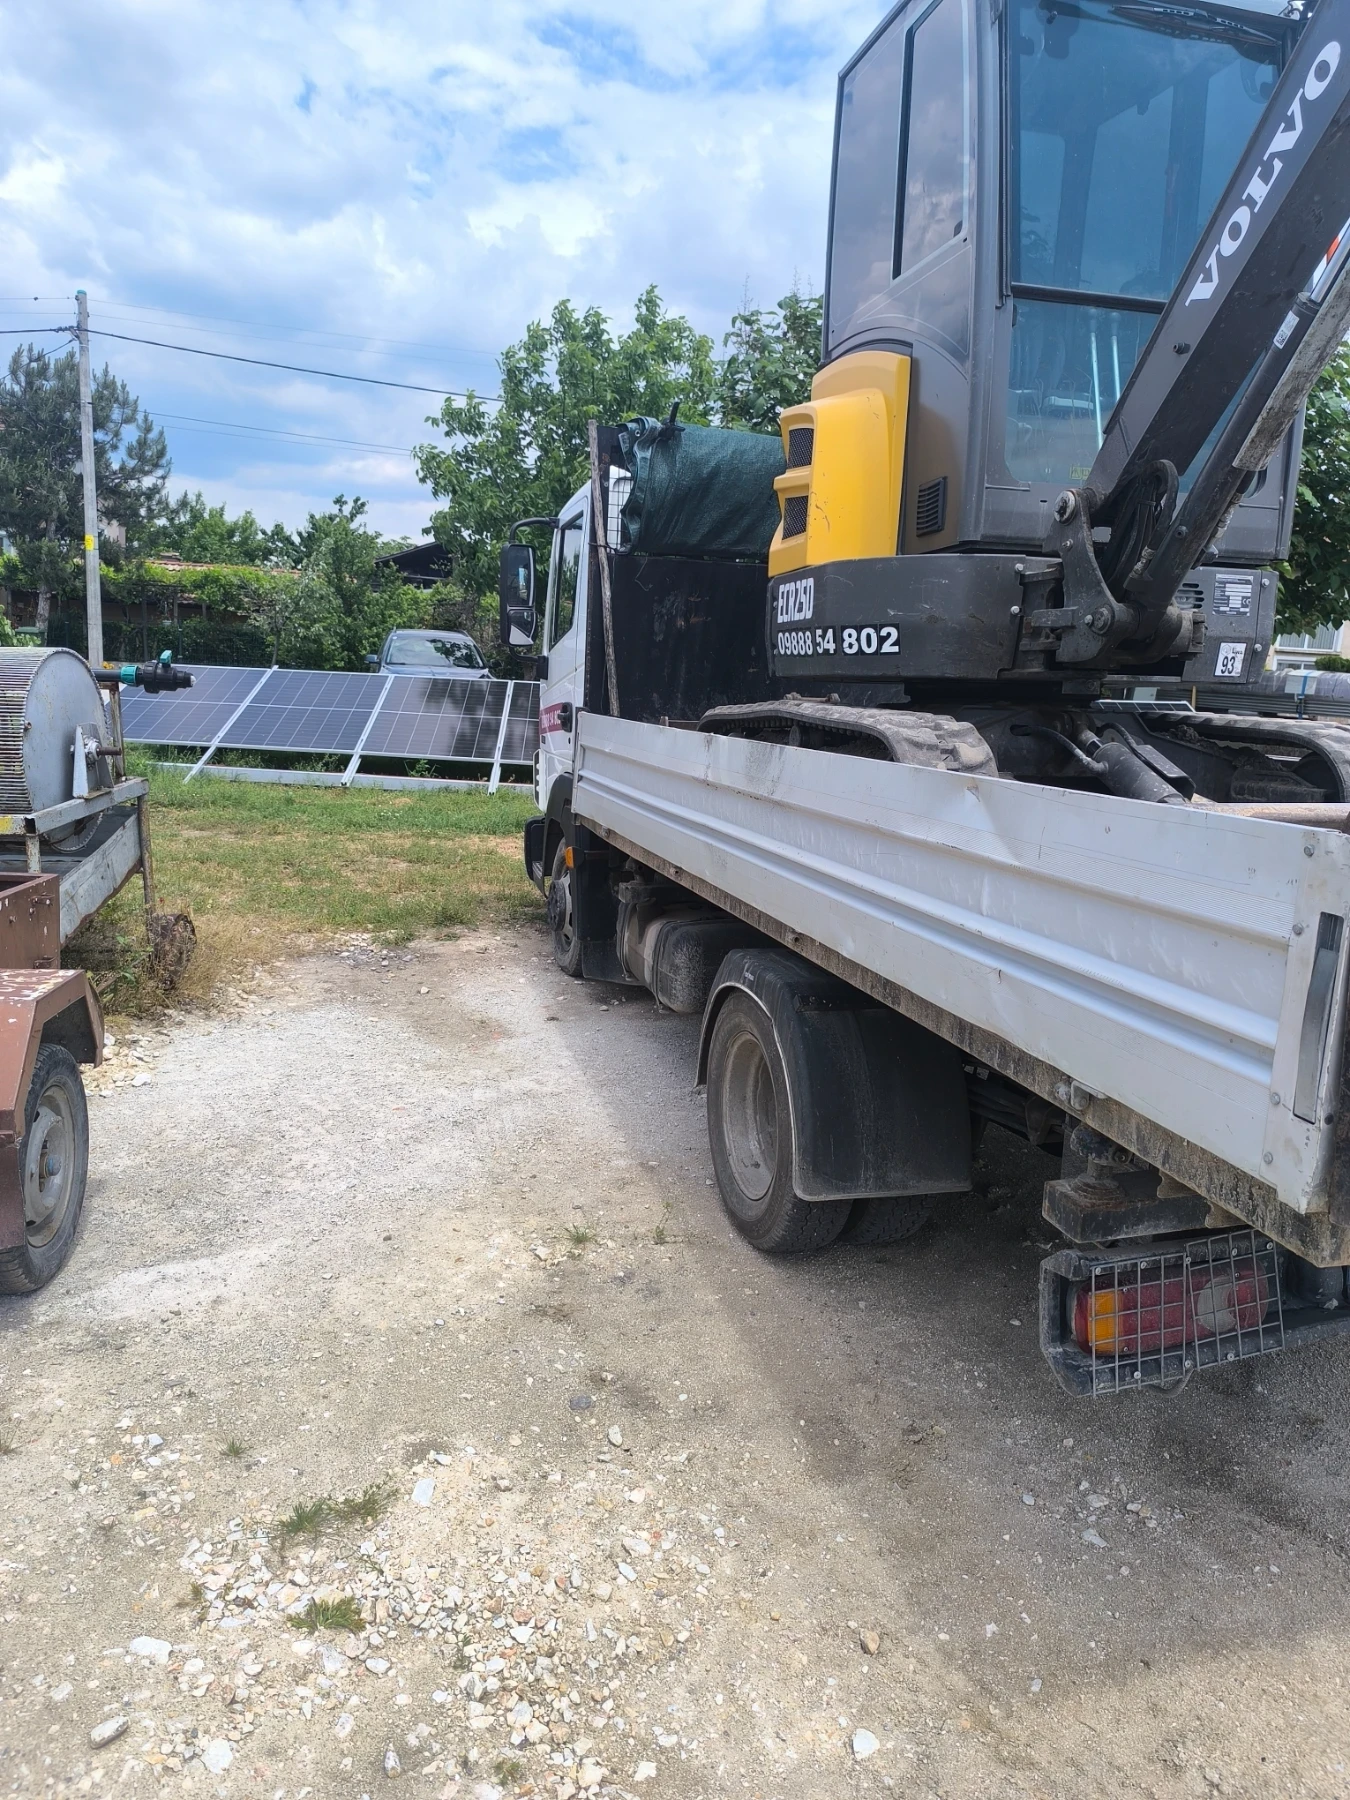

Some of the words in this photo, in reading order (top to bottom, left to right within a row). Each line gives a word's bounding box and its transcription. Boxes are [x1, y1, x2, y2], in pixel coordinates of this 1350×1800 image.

[1185, 41, 1341, 307] VOLVO
[777, 578, 814, 623] ECR25D
[777, 631, 814, 655] 09888
[815, 628, 836, 654] 54
[842, 626, 899, 654] 802
[1220, 655, 1236, 674] 93
